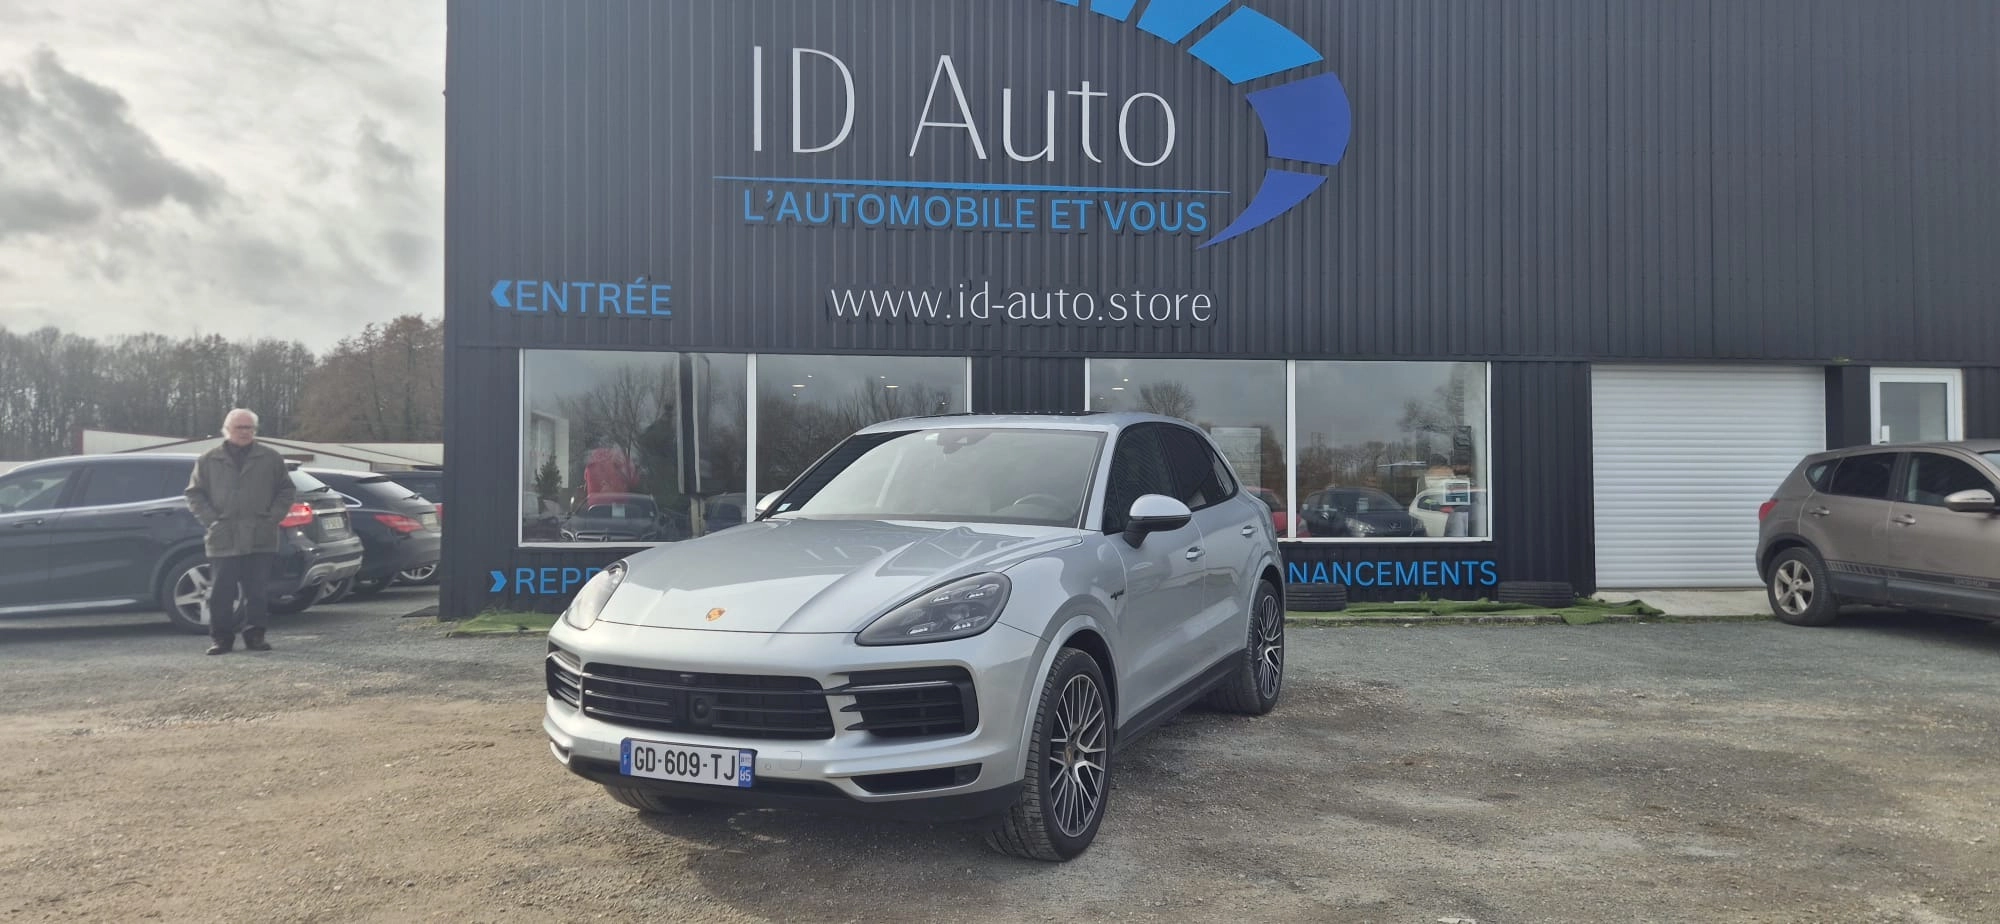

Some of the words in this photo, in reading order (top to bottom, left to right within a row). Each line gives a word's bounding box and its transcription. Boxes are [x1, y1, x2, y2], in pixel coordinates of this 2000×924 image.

[753, 46, 855, 153] ID
[909, 54, 1176, 167] Auto
[1050, 198, 1094, 230] ET
[1103, 200, 1208, 233] VOUS
[515, 277, 672, 316] ENTRÉE
[830, 281, 1212, 321] www.id-auto.store
[1288, 560, 1498, 587] NANCEMENTS
[634, 746, 735, 781] GD-609-TJ
